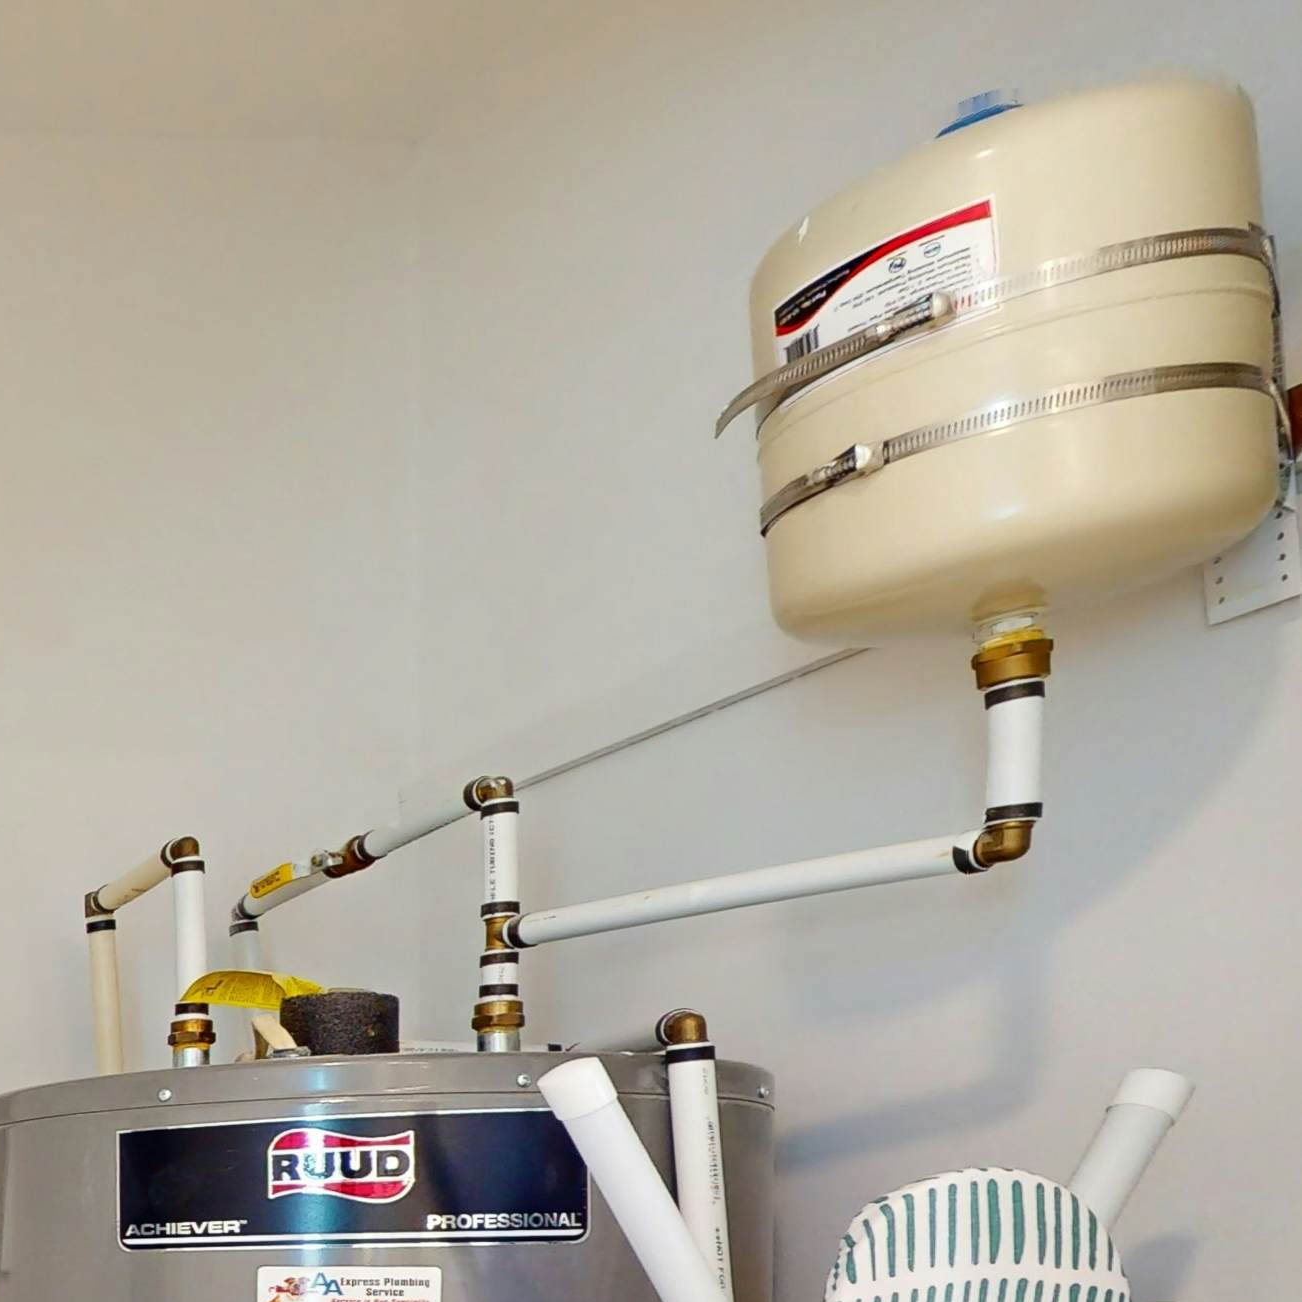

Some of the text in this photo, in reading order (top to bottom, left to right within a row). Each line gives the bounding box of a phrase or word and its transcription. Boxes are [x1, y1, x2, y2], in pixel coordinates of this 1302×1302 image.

[270, 1150, 410, 1182] RUUD
[341, 1277, 430, 1288] Express Plumbing
[366, 1287, 405, 1297] Service
